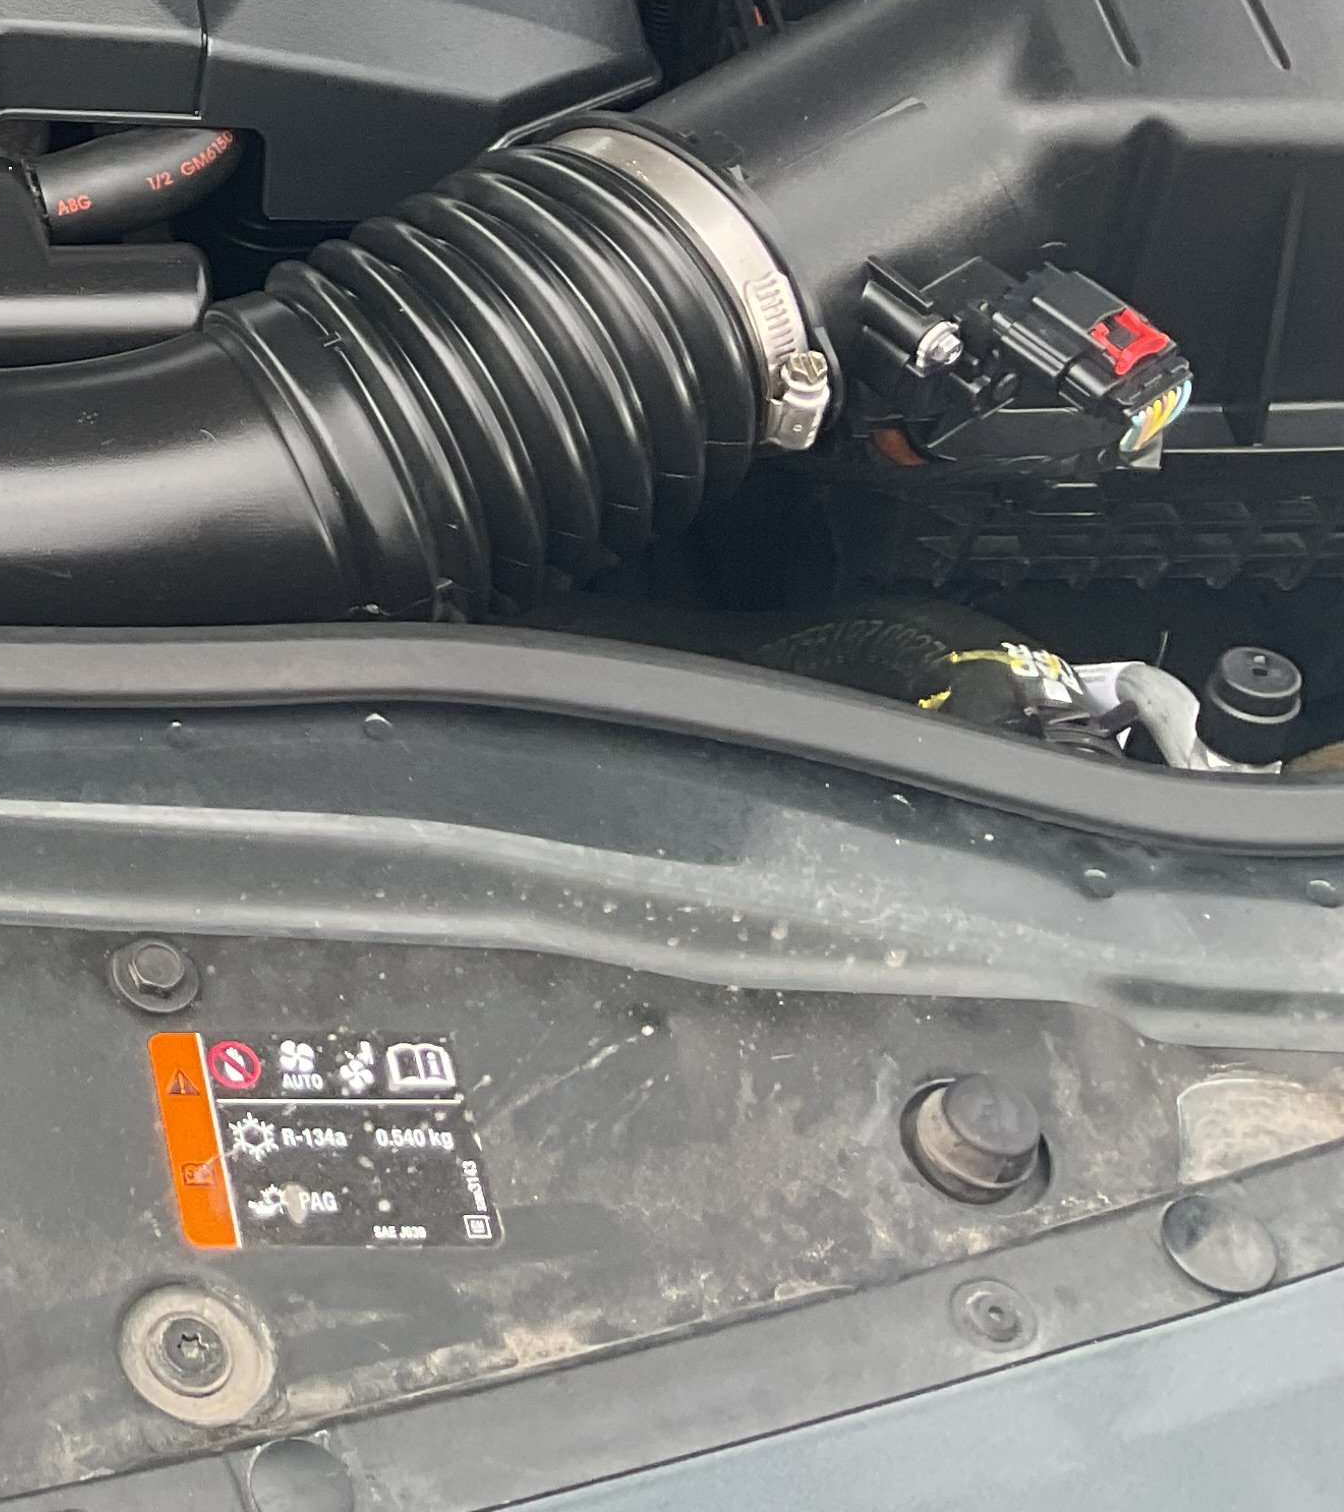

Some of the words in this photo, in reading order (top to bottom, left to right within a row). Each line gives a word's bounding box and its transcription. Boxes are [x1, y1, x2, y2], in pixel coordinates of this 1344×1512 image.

[57, 194, 92, 217] ABG
[145, 171, 174, 191] 1/2
[282, 1074, 323, 1090] AUTO
[281, 1127, 348, 1148] R-134a
[375, 1128, 425, 1148] 0.540
[428, 1128, 454, 1150] kg
[299, 1191, 338, 1213] PAG
